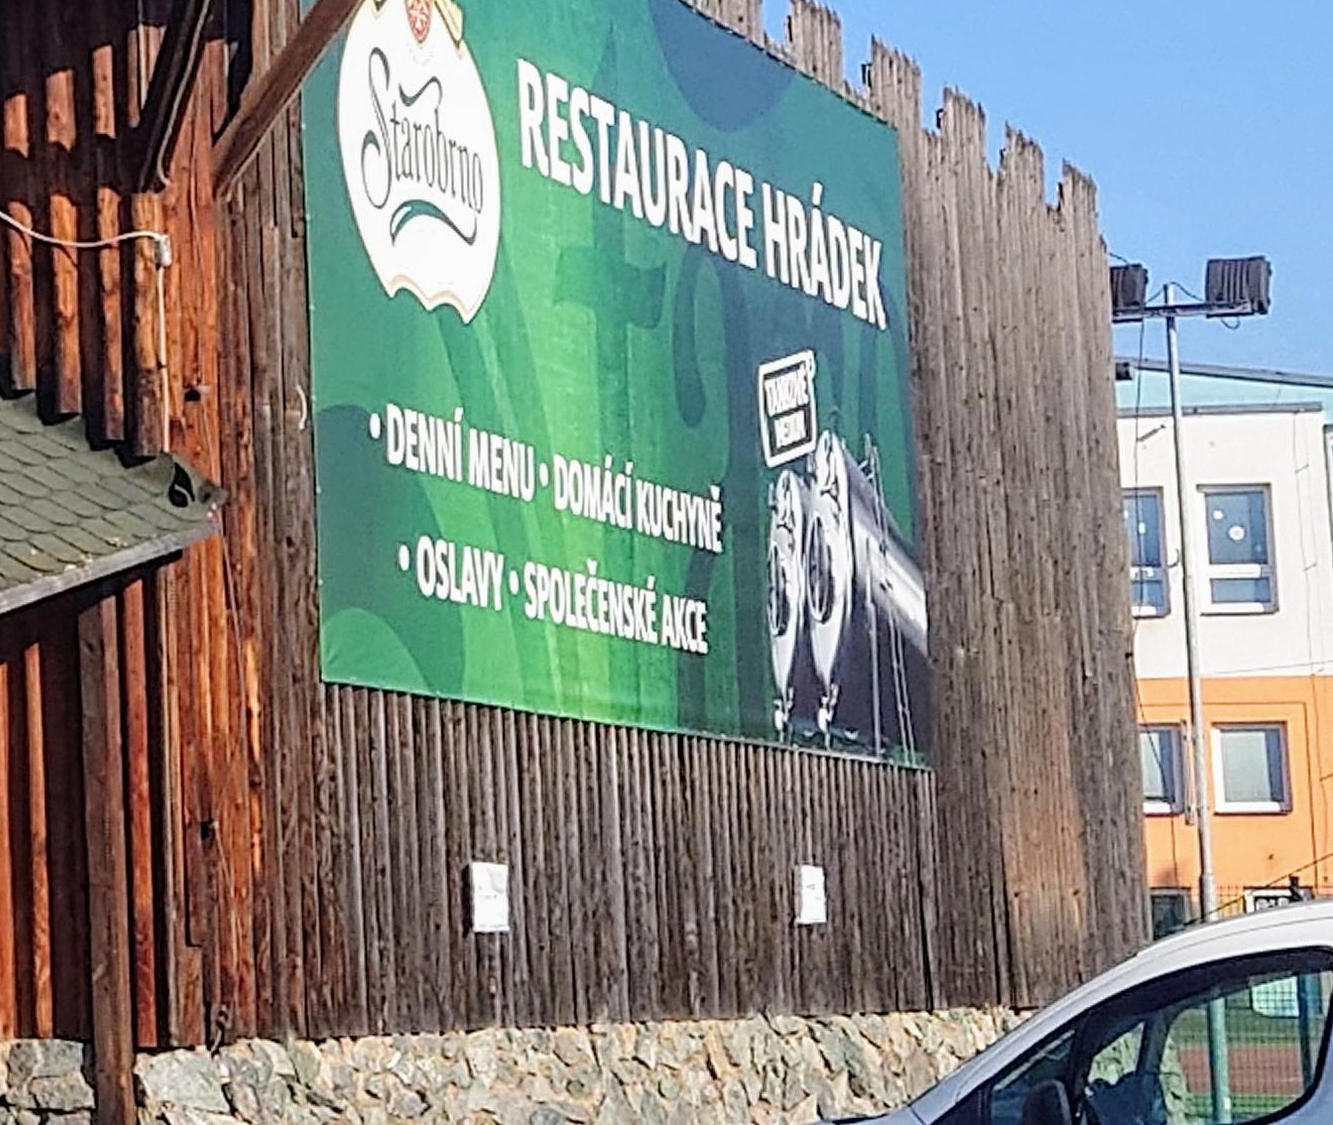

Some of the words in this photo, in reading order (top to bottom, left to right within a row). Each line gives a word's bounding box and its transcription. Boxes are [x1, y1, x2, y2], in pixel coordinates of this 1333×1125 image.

[361, 46, 484, 220] Starobrno
[517, 58, 757, 269] RESTAURACE
[761, 181, 886, 331] HRÁDEK
[386, 402, 464, 483] DENNÍ
[468, 427, 535, 502] MENU
[553, 453, 633, 530] DOMÁCÍ
[636, 478, 723, 553] KUCHYNĚ
[416, 535, 505, 611] OSLAVY
[523, 557, 658, 644] SPOLEČENSKÉ
[661, 593, 709, 654] AKCE
